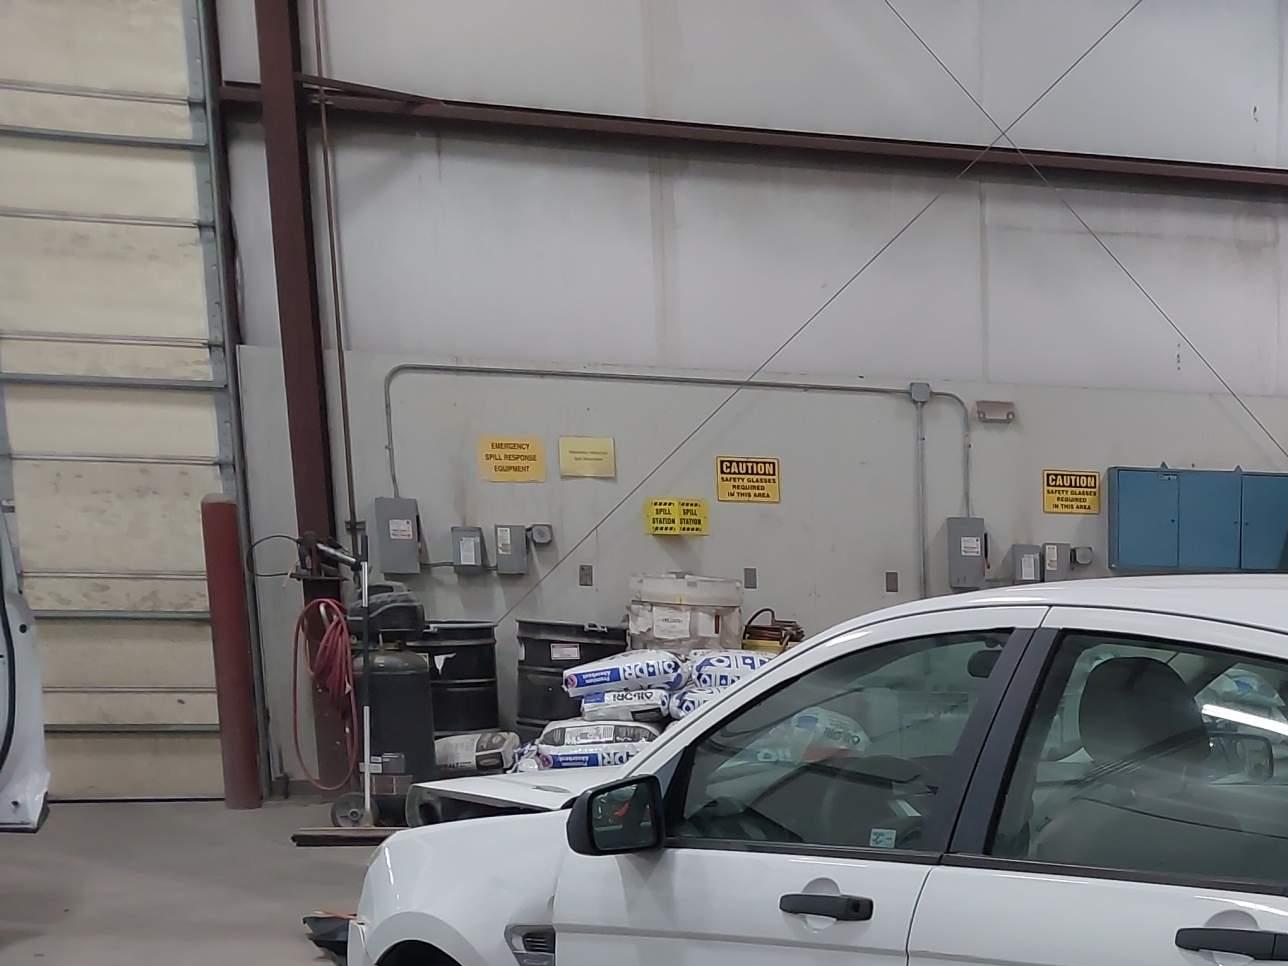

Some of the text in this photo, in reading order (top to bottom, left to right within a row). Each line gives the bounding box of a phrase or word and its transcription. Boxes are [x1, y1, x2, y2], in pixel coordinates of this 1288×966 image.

[491, 442, 529, 450] EMERGENCY
[504, 454, 536, 462] RESPONSE
[494, 465, 530, 473] EQUIPMENT
[722, 462, 774, 475] CAUTION
[1048, 474, 1095, 487] CAUTION
[655, 508, 672, 516] SPILL
[682, 508, 698, 516] SPILL
[652, 517, 676, 525] STATION
[680, 518, 702, 526] STATION
